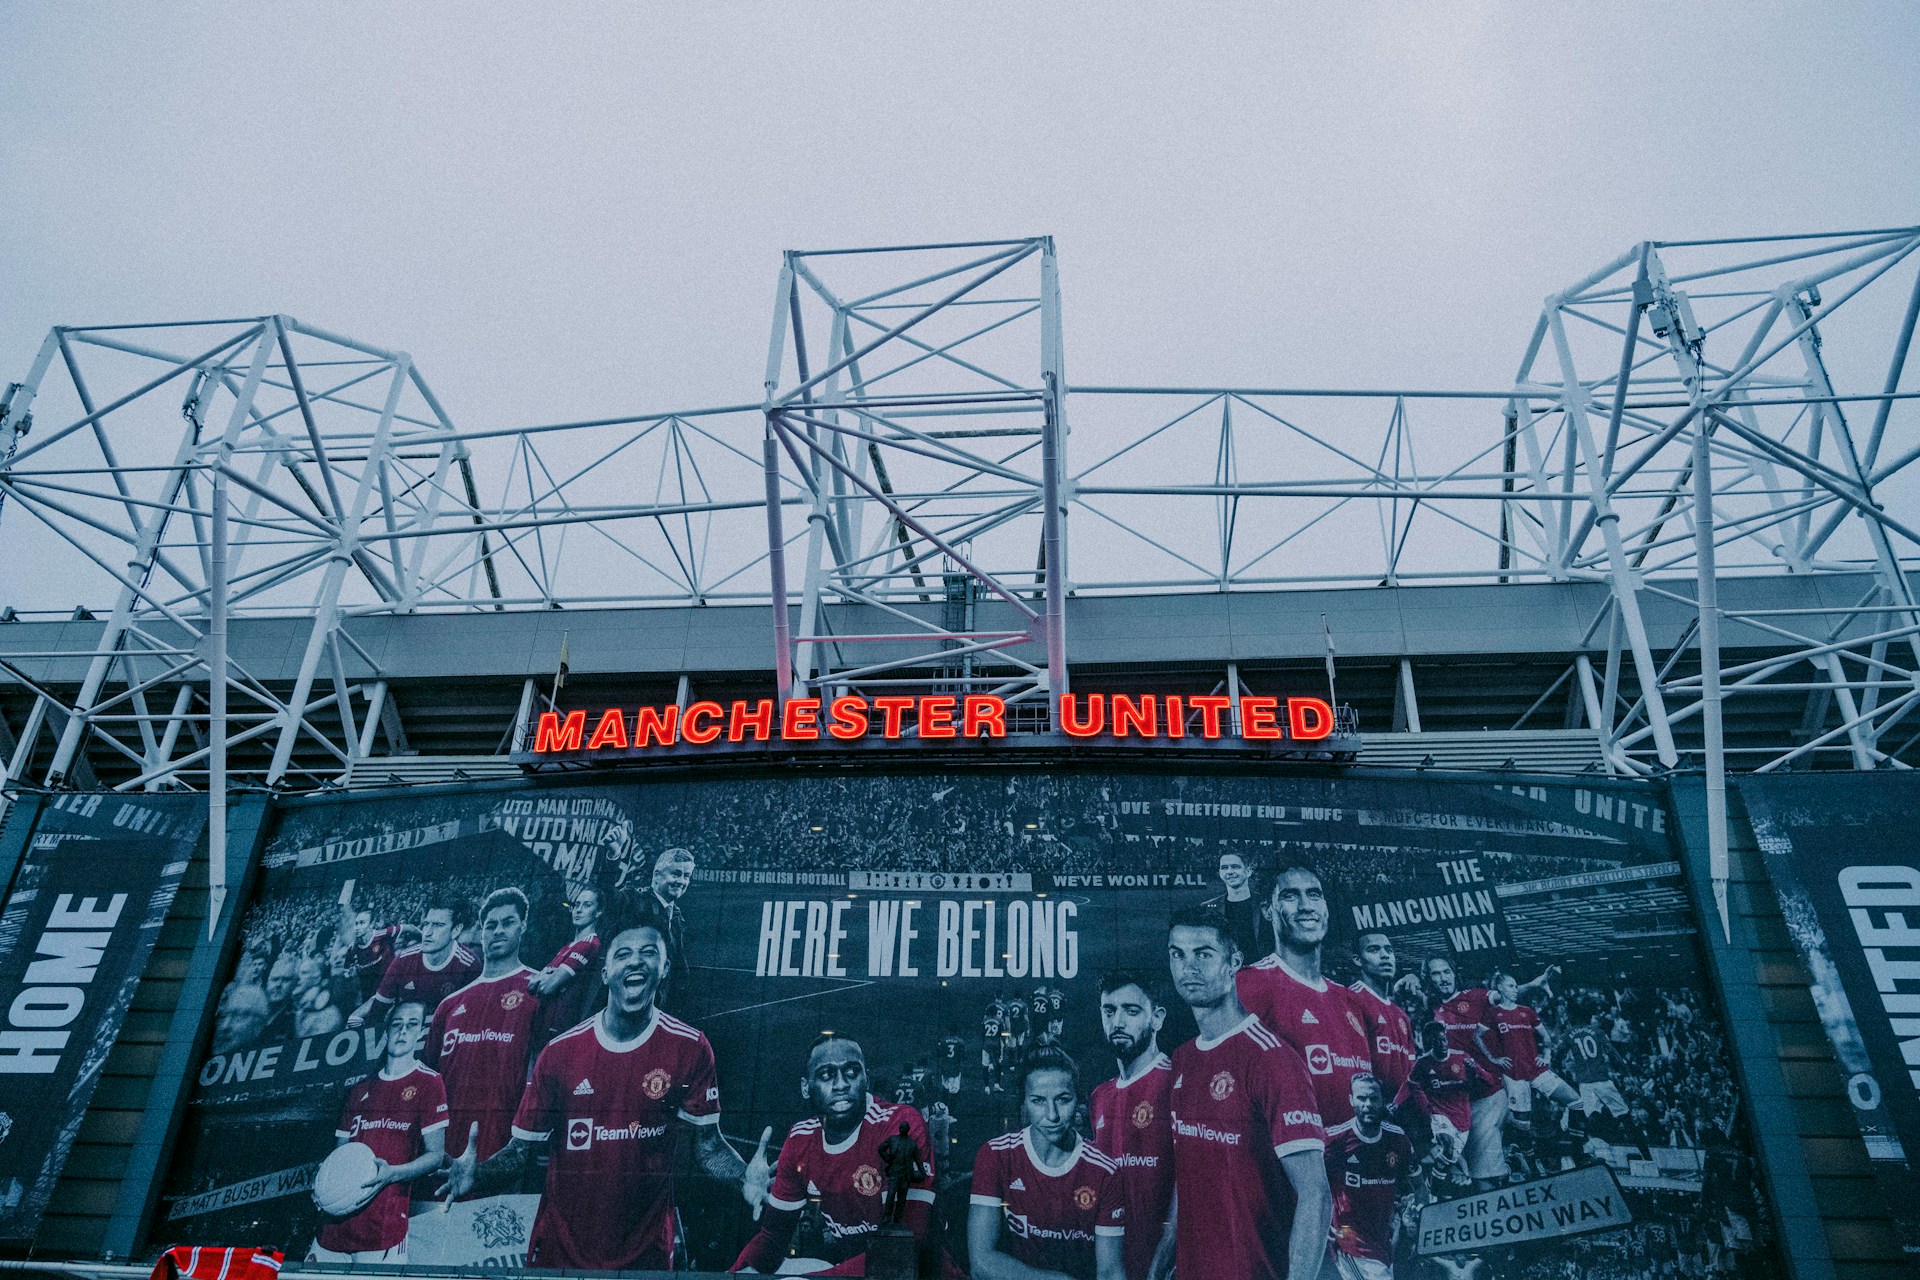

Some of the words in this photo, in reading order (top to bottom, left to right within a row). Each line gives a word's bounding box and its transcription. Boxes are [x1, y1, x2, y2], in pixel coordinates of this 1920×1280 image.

[533, 693, 1006, 753] MANCHESTER
[1059, 693, 1336, 740] UNITED
[536, 798, 568, 816] MAN
[1164, 802, 1252, 819] STRETFORD
[1256, 804, 1286, 820] END
[1301, 807, 1343, 822] MUFC
[522, 817, 567, 842] UTD
[313, 829, 426, 864] ADORED
[740, 870, 751, 883] OF
[753, 871, 794, 884] ENGLISH
[796, 873, 847, 886] FOOTBALL
[1052, 873, 1103, 888] WE'VE
[1107, 873, 1149, 888] WON
[1151, 873, 1171, 887] IT
[1173, 873, 1206, 887] ALL
[1437, 858, 1484, 886] THE
[1351, 889, 1495, 931] MANCUNIAN
[755, 901, 851, 978] HERE
[867, 900, 922, 978] WE
[936, 900, 1079, 979] BELONG
[1447, 922, 1506, 952] WAY.
[0, 893, 128, 1074] HOME
[1012, 1007, 1020, 1018] 2
[1033, 1001, 1047, 1013] 26
[457, 1018, 515, 1044] TeamViewer
[984, 1024, 999, 1036] 29
[947, 1043, 955, 1058] 3
[1574, 1035, 1598, 1060] 10
[199, 1045, 284, 1087] ONE
[895, 1088, 915, 1104] 23
[360, 1117, 412, 1131] TeamViewer
[593, 1123, 668, 1142] TeamViewer
[1175, 1119, 1242, 1146] TeamViewer
[189, 1191, 222, 1212] MATT
[222, 1179, 270, 1205] BUSBY
[1456, 1200, 1489, 1220] SIR
[1496, 1184, 1556, 1213] ALEX
[1422, 1210, 1546, 1249] FERGUSON
[1551, 1196, 1615, 1227] WAY
